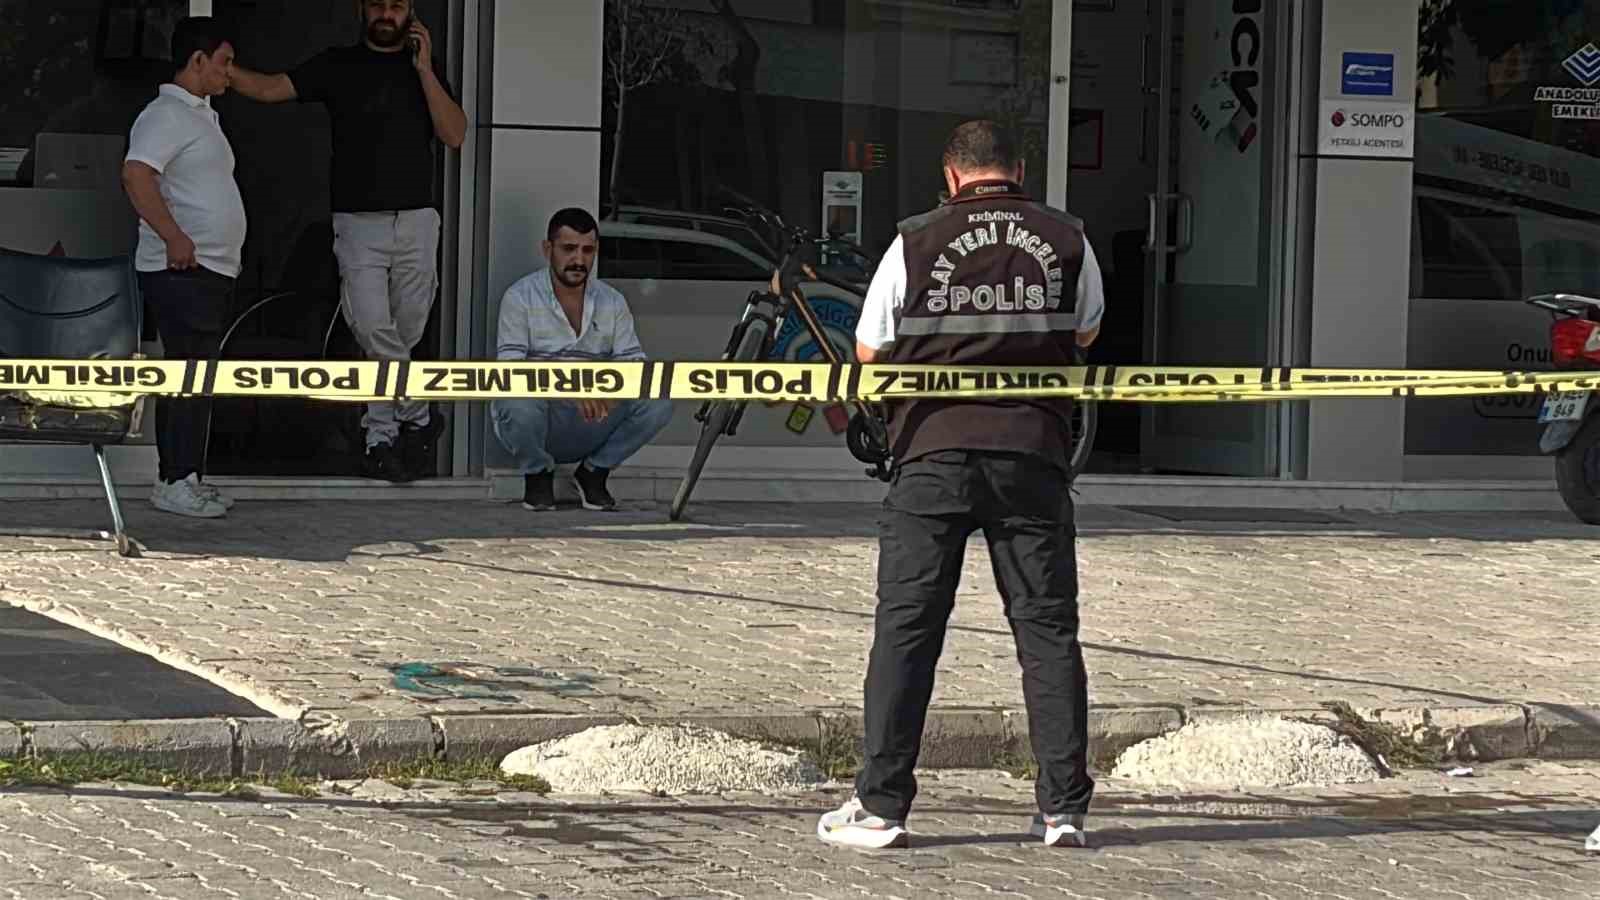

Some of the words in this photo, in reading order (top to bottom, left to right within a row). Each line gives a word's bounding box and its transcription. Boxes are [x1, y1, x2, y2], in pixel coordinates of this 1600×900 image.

[1351, 113, 1404, 127] SOMPO
[927, 253, 956, 312] OLAY
[949, 276, 1046, 312] POLİS
[233, 366, 360, 390] POLİS
[423, 368, 625, 393] GİRİLMEZ
[689, 369, 812, 395] POLİS
